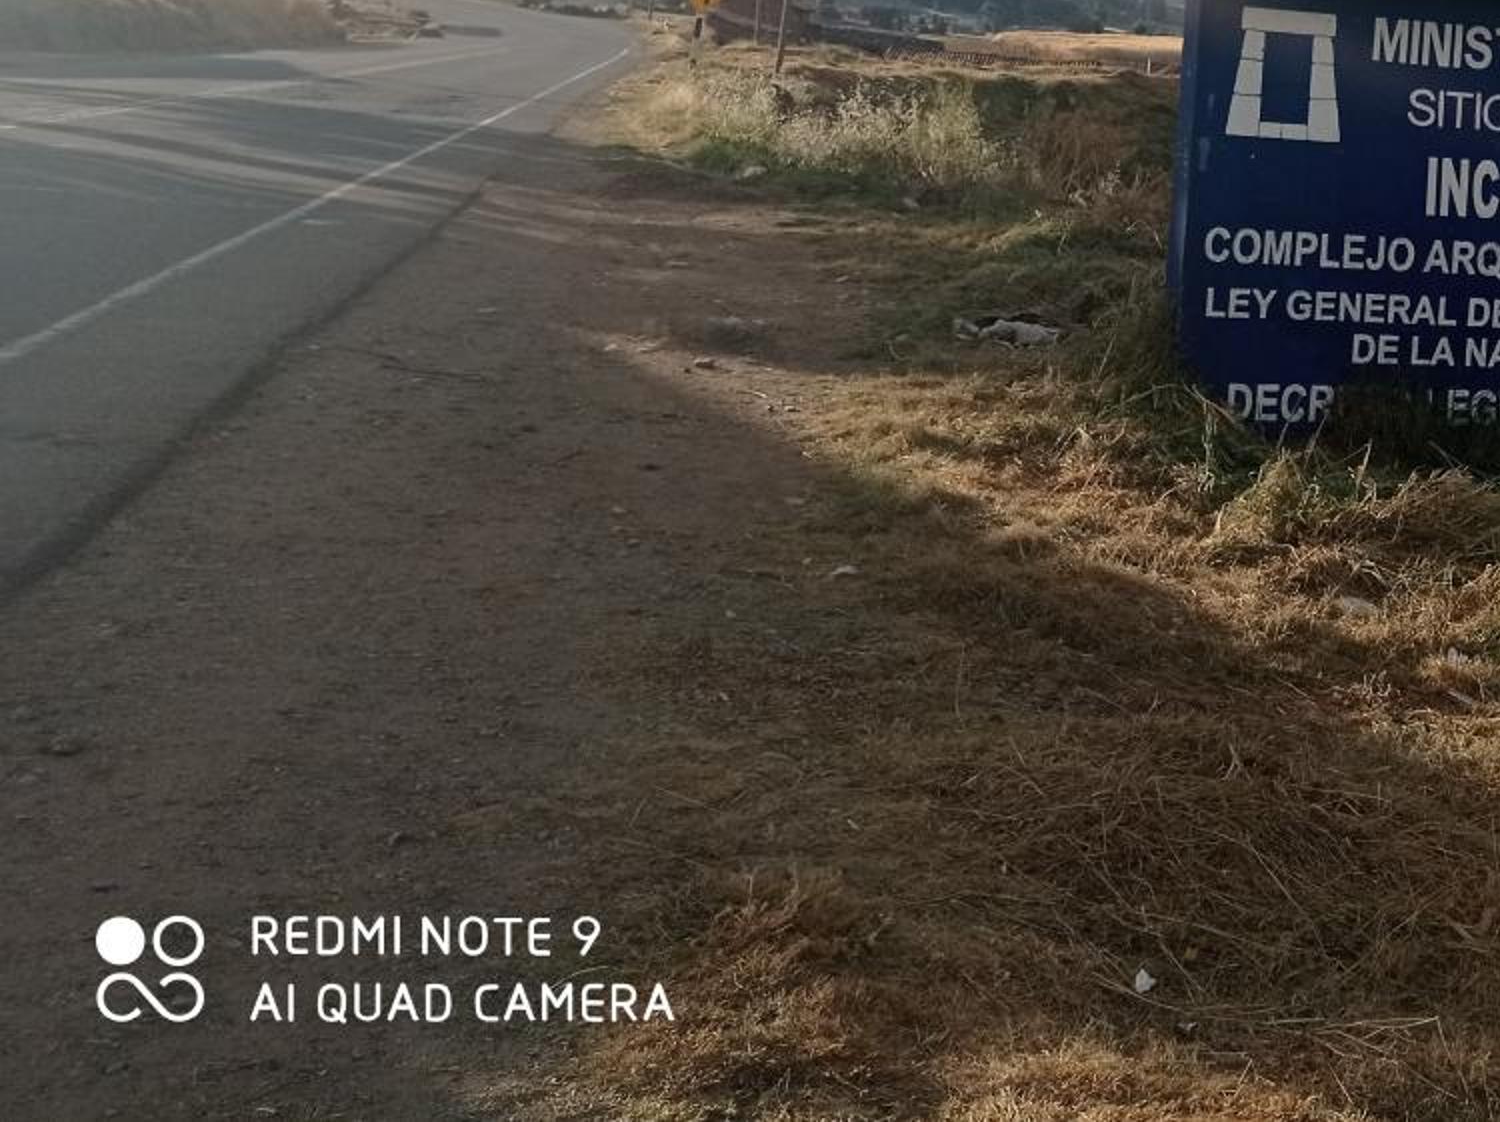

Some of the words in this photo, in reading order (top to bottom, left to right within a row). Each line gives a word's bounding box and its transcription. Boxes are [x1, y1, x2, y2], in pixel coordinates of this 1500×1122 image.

[1205, 227, 1415, 272] COMPLEJO
[1205, 287, 1277, 320] LEY
[1286, 290, 1457, 327] GENERAL
[1351, 333, 1399, 365] DE
[1410, 335, 1455, 368] LA
